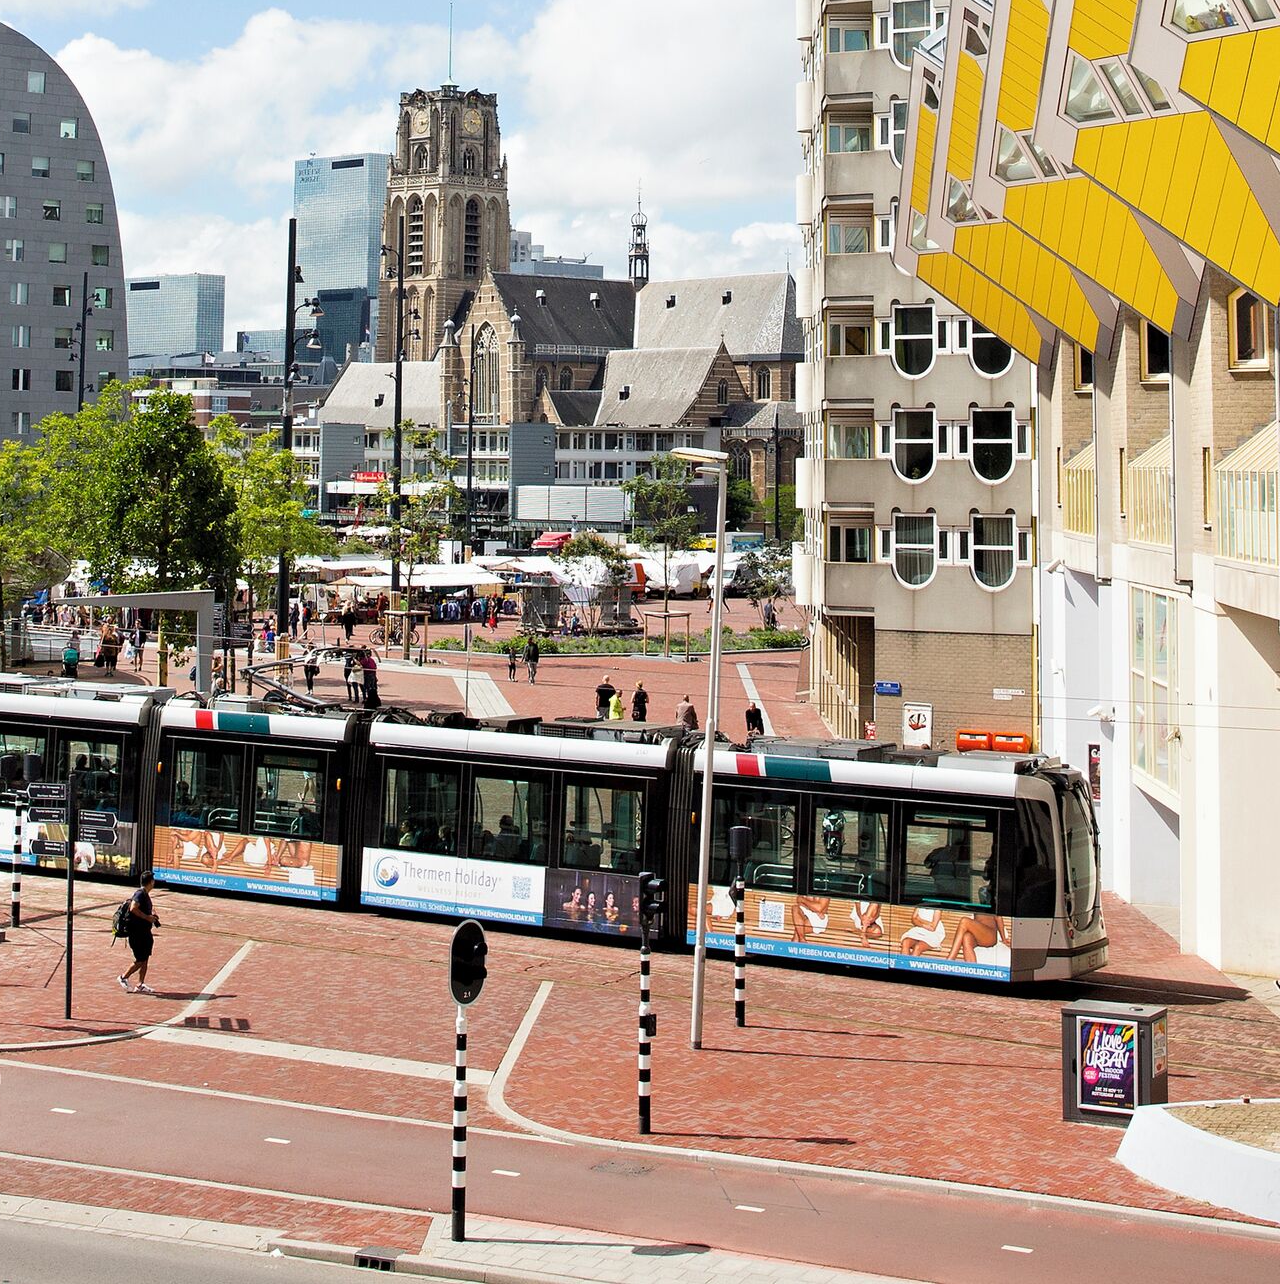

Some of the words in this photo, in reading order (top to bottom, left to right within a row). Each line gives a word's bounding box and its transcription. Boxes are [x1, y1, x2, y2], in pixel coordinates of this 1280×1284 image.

[181, 875, 203, 883] MASSAGE
[208, 878, 226, 886] BEAUTY
[402, 861, 451, 882] Thermen
[455, 867, 499, 892] Holiday
[365, 896, 386, 904] PRINSES
[428, 901, 454, 912] SCHIEDAM
[458, 906, 536, 923] WWW.THERMENHOLIDAY.NL
[752, 942, 775, 951] BEAUTY
[798, 948, 823, 957] HEBBEN
[823, 950, 837, 958] OOK
[1086, 1049, 1129, 1071] URBAN
